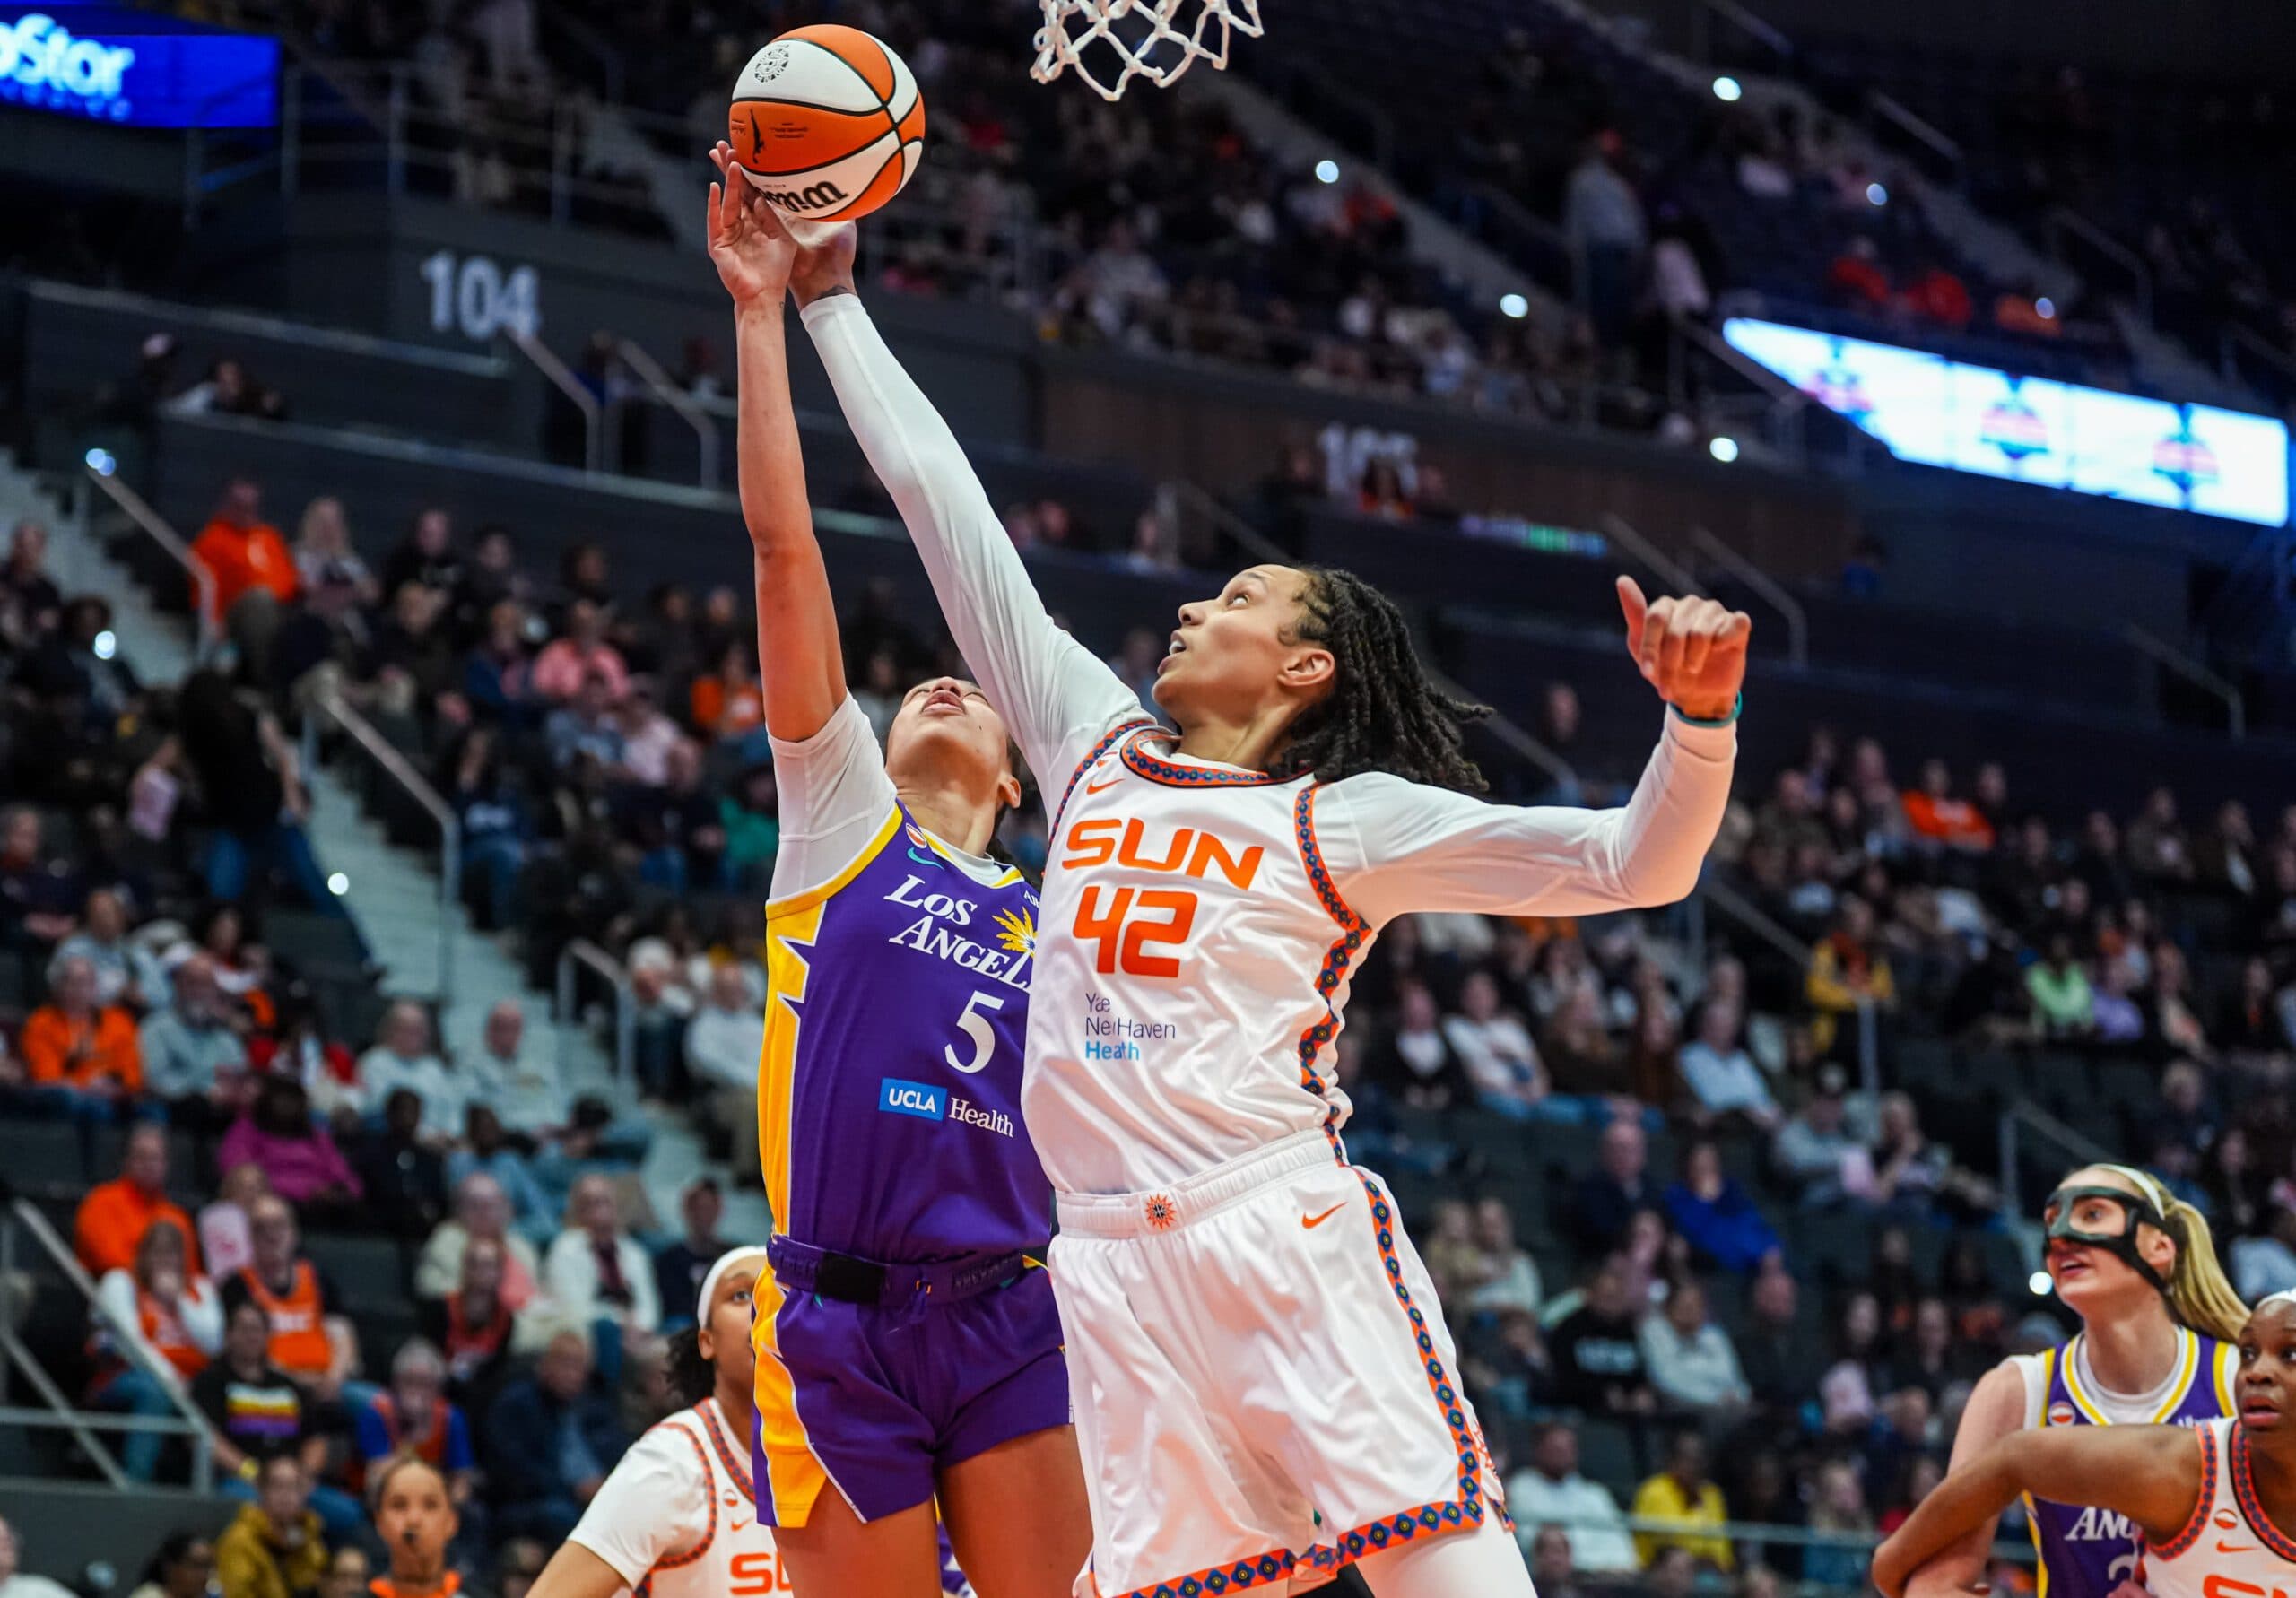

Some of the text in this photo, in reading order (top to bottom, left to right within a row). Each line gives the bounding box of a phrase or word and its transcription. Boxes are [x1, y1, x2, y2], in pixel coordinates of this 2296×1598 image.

[420, 251, 543, 341] 104
[1062, 817, 1265, 891] SUN
[883, 873, 978, 926] LOS
[1072, 885, 1198, 978] 42
[889, 915, 1031, 994] ANGEL
[944, 990, 1005, 1073] 5
[1118, 1017, 1177, 1039] Haven
[888, 1088, 1014, 1138] UCLA Health
